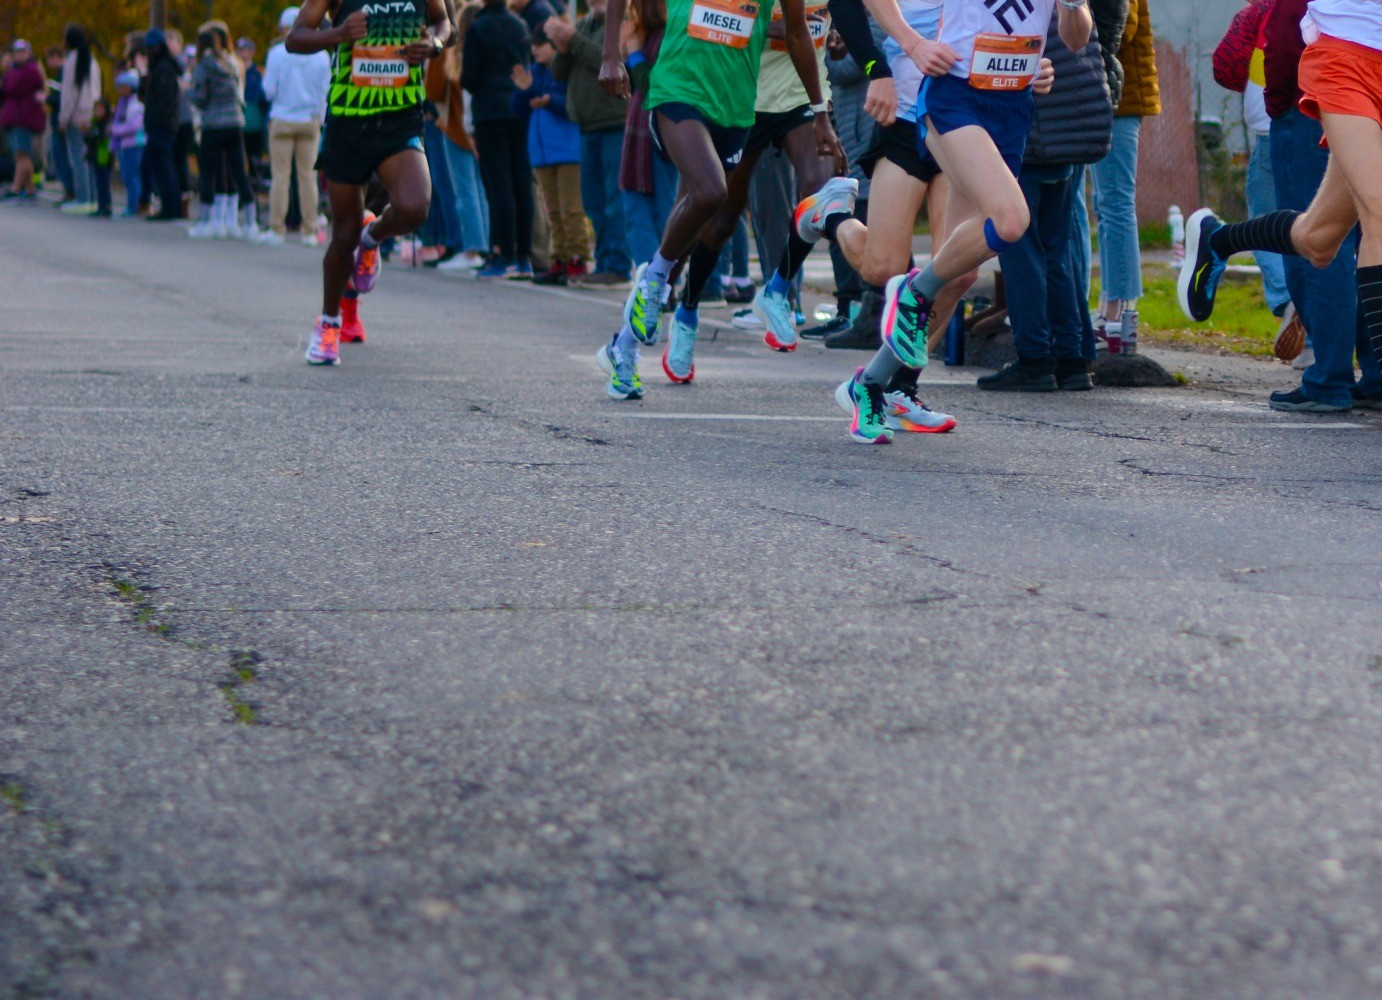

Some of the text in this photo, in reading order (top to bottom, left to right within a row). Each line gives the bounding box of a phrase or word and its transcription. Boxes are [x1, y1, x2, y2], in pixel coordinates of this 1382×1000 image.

[361, 1, 416, 14] ANTA
[702, 11, 742, 32] MESEL
[708, 30, 733, 44] ELITE
[359, 62, 404, 74] ADRARO
[986, 57, 1028, 72] ALLEN
[992, 77, 1019, 87] ELITE
